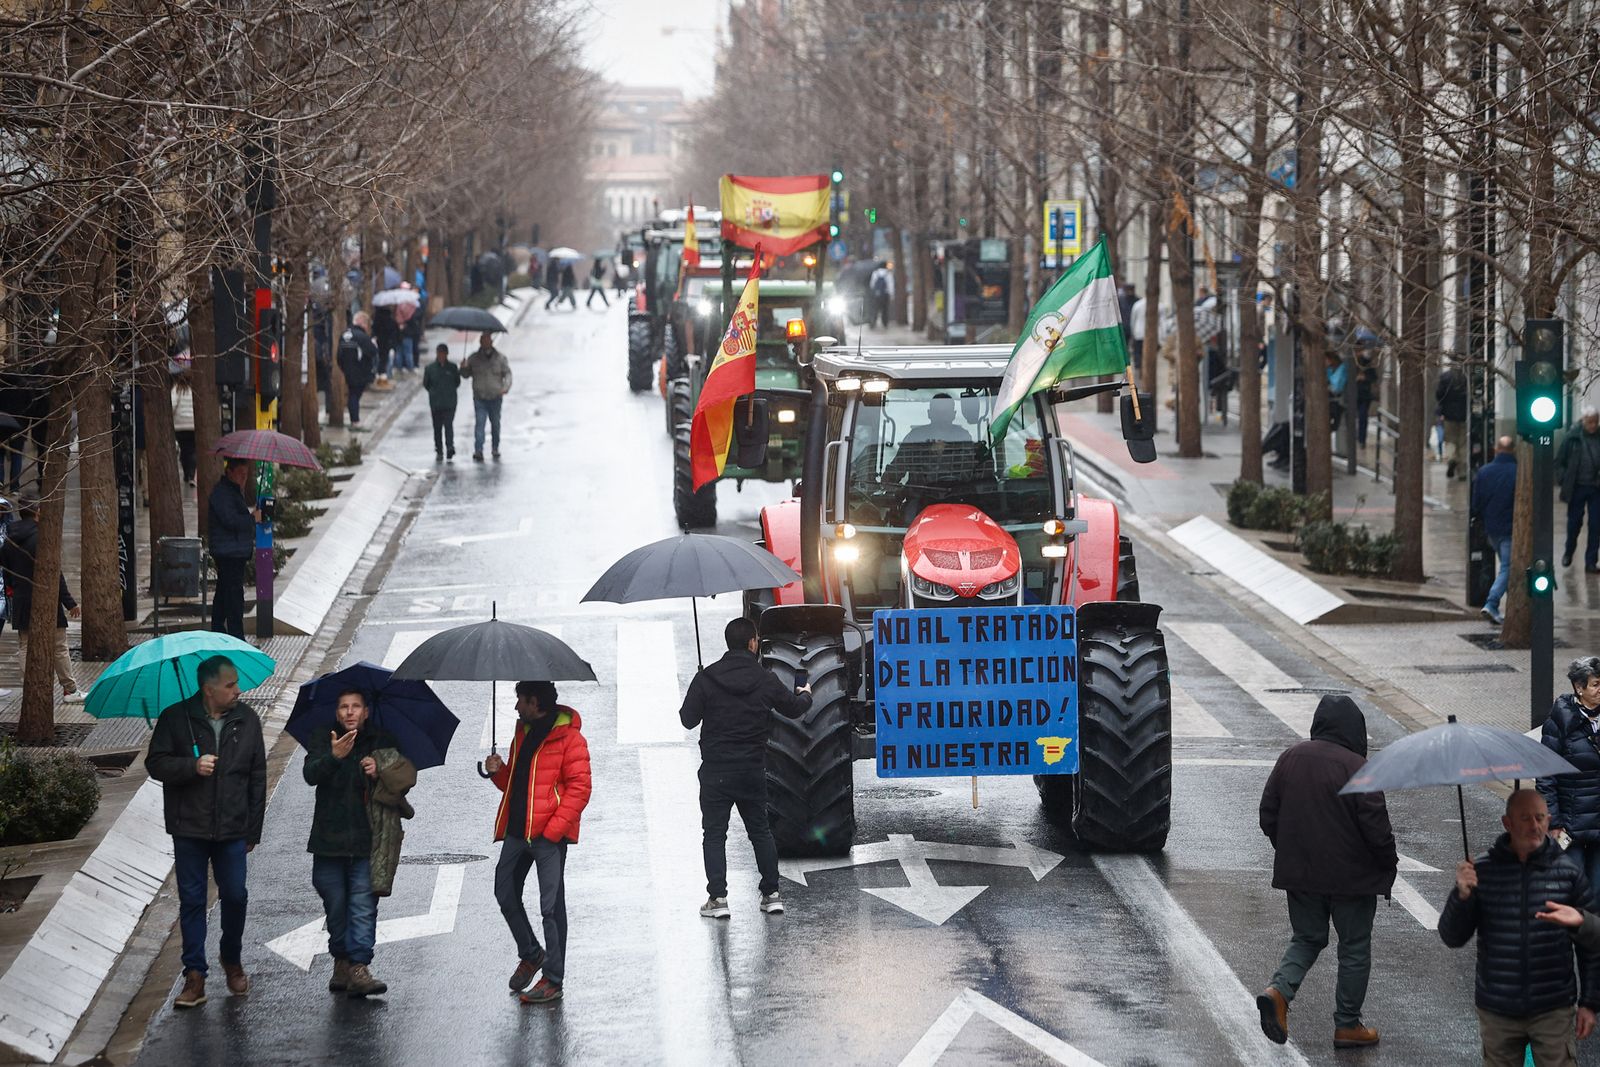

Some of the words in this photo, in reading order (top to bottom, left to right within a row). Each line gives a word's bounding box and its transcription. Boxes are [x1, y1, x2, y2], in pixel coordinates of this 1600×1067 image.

[877, 617, 910, 645] NO
[917, 616, 950, 644] AL
[957, 613, 1075, 643] TRATADO
[878, 660, 910, 687] DE
[919, 659, 950, 686] LA
[881, 744, 897, 770] A
[907, 741, 1030, 769] NUESTRA
